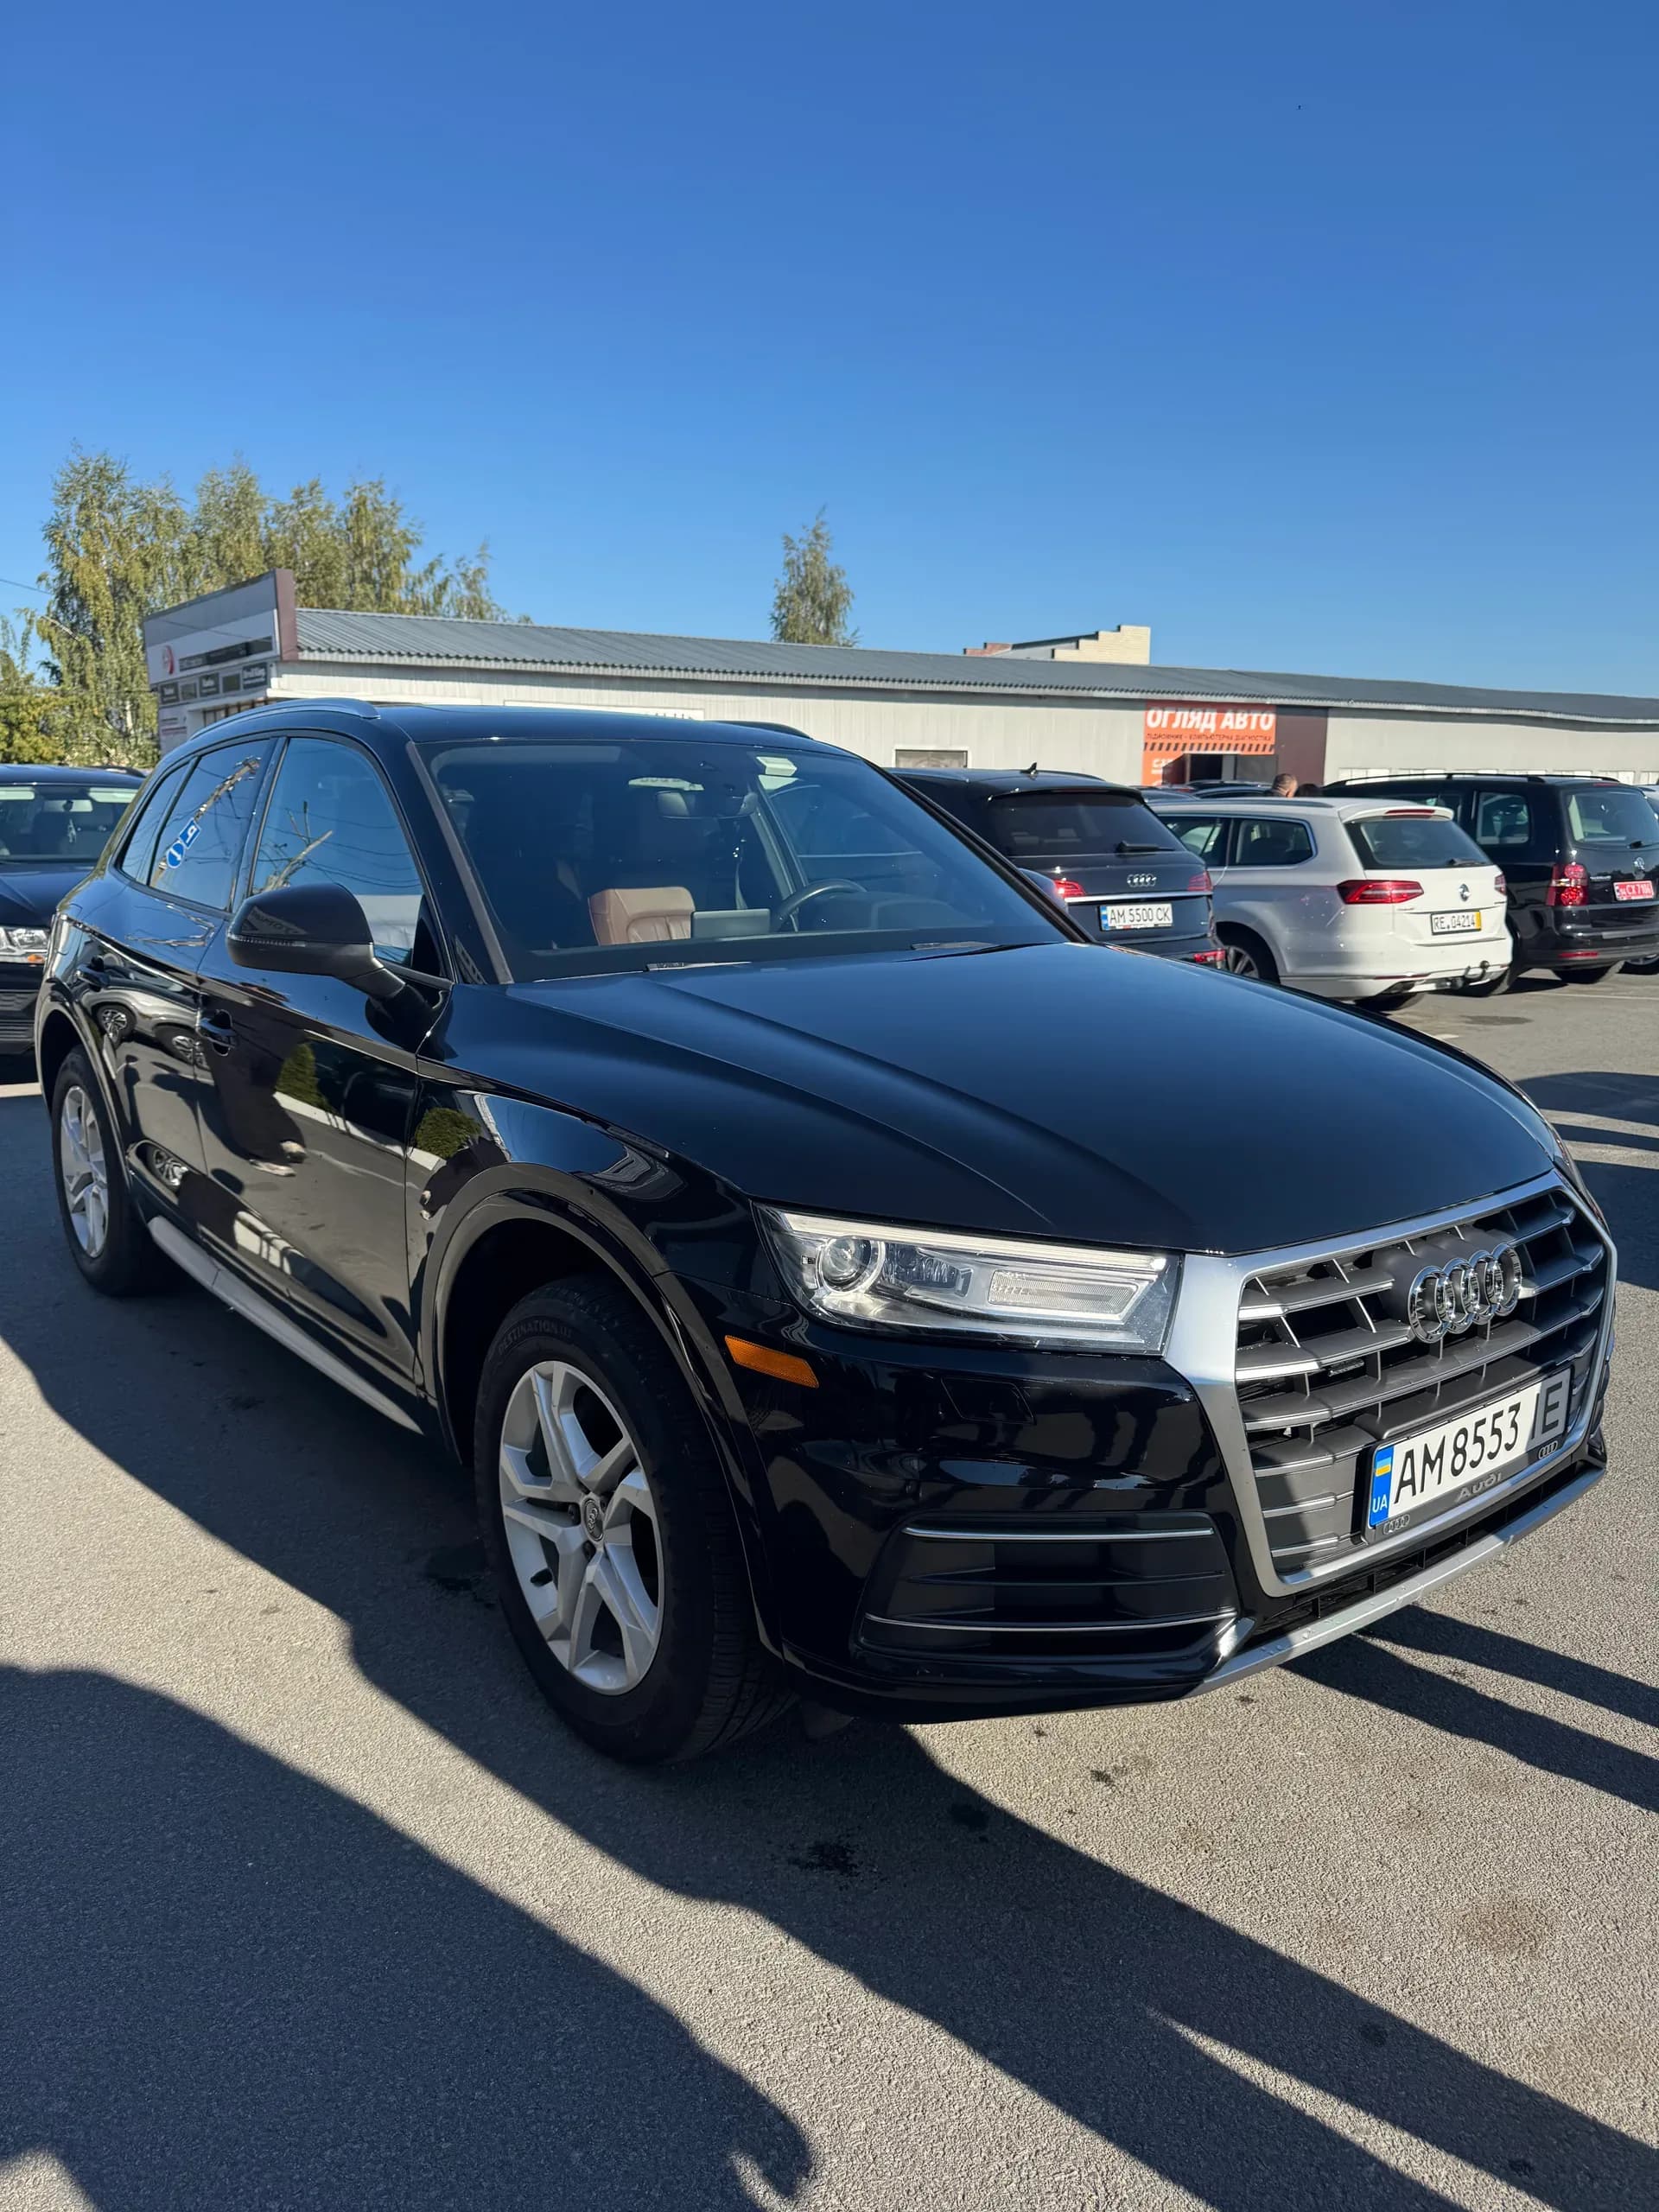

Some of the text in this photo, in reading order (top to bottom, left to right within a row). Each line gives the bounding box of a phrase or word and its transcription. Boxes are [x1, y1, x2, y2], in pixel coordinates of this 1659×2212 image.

[1147, 708, 1275, 733] ОГЛЯД АВТО
[1109, 909, 1127, 924] AM
[1128, 908, 1154, 923] 5500
[1156, 906, 1171, 921] CK
[1433, 916, 1446, 930] RE
[1394, 1380, 1563, 1504] AM 8553 IE
[1456, 1471, 1503, 1503] Audi
[1372, 1494, 1388, 1513] UA
